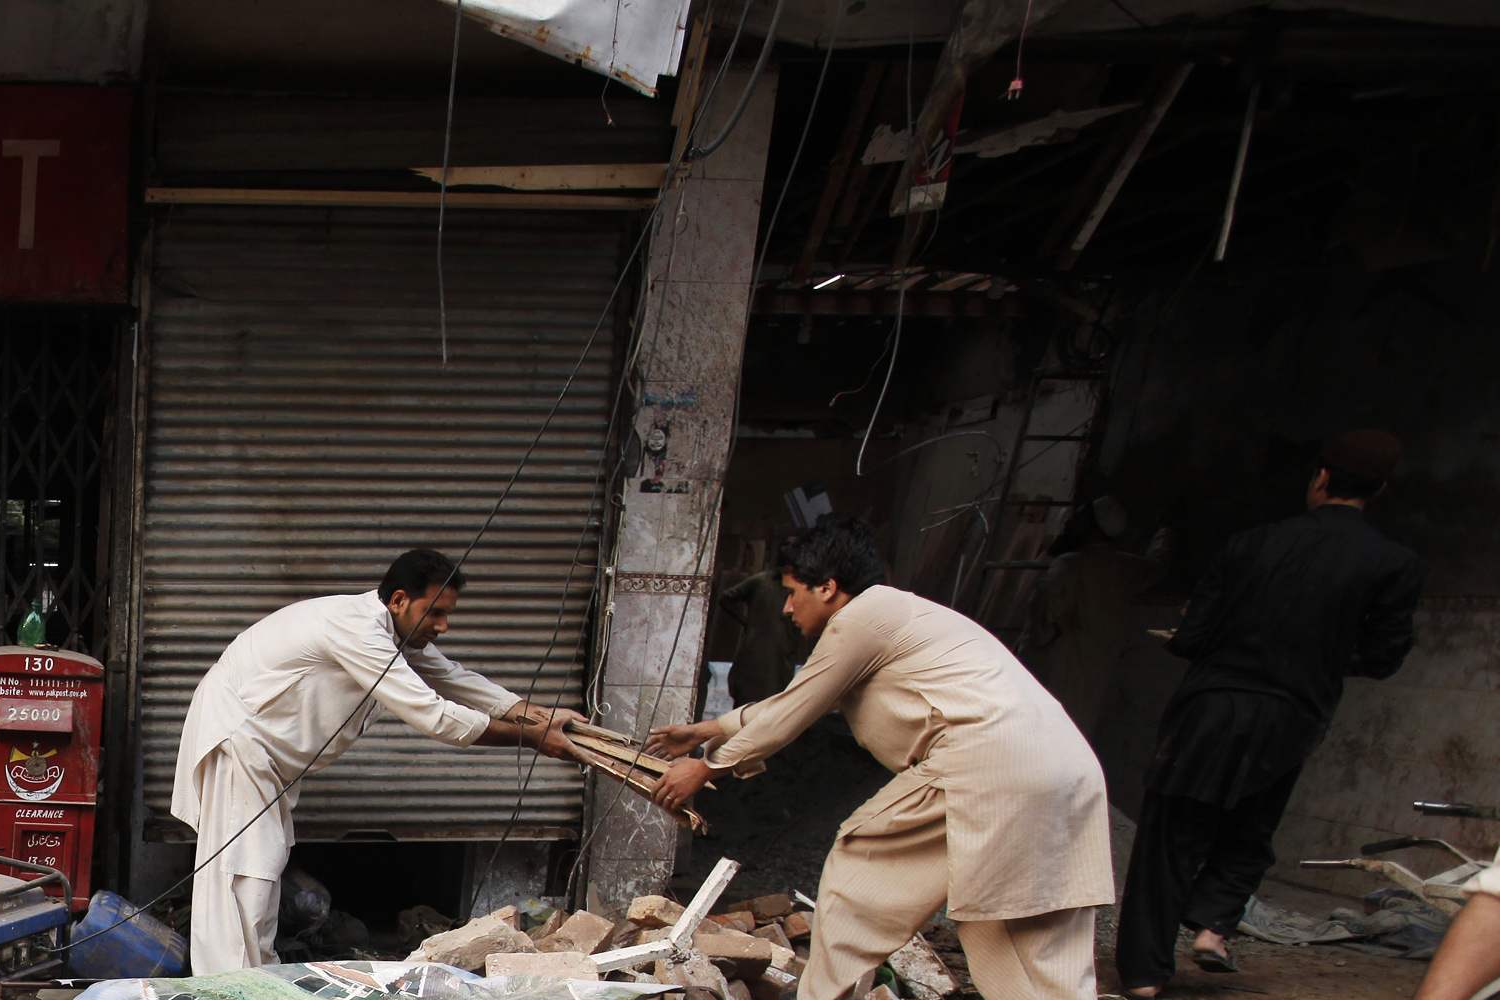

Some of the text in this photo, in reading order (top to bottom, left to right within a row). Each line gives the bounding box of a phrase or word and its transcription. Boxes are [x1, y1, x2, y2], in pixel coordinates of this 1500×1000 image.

[24, 656, 54, 672] 130
[8, 707, 60, 721] 25000
[15, 809, 65, 819] CLEARANCE
